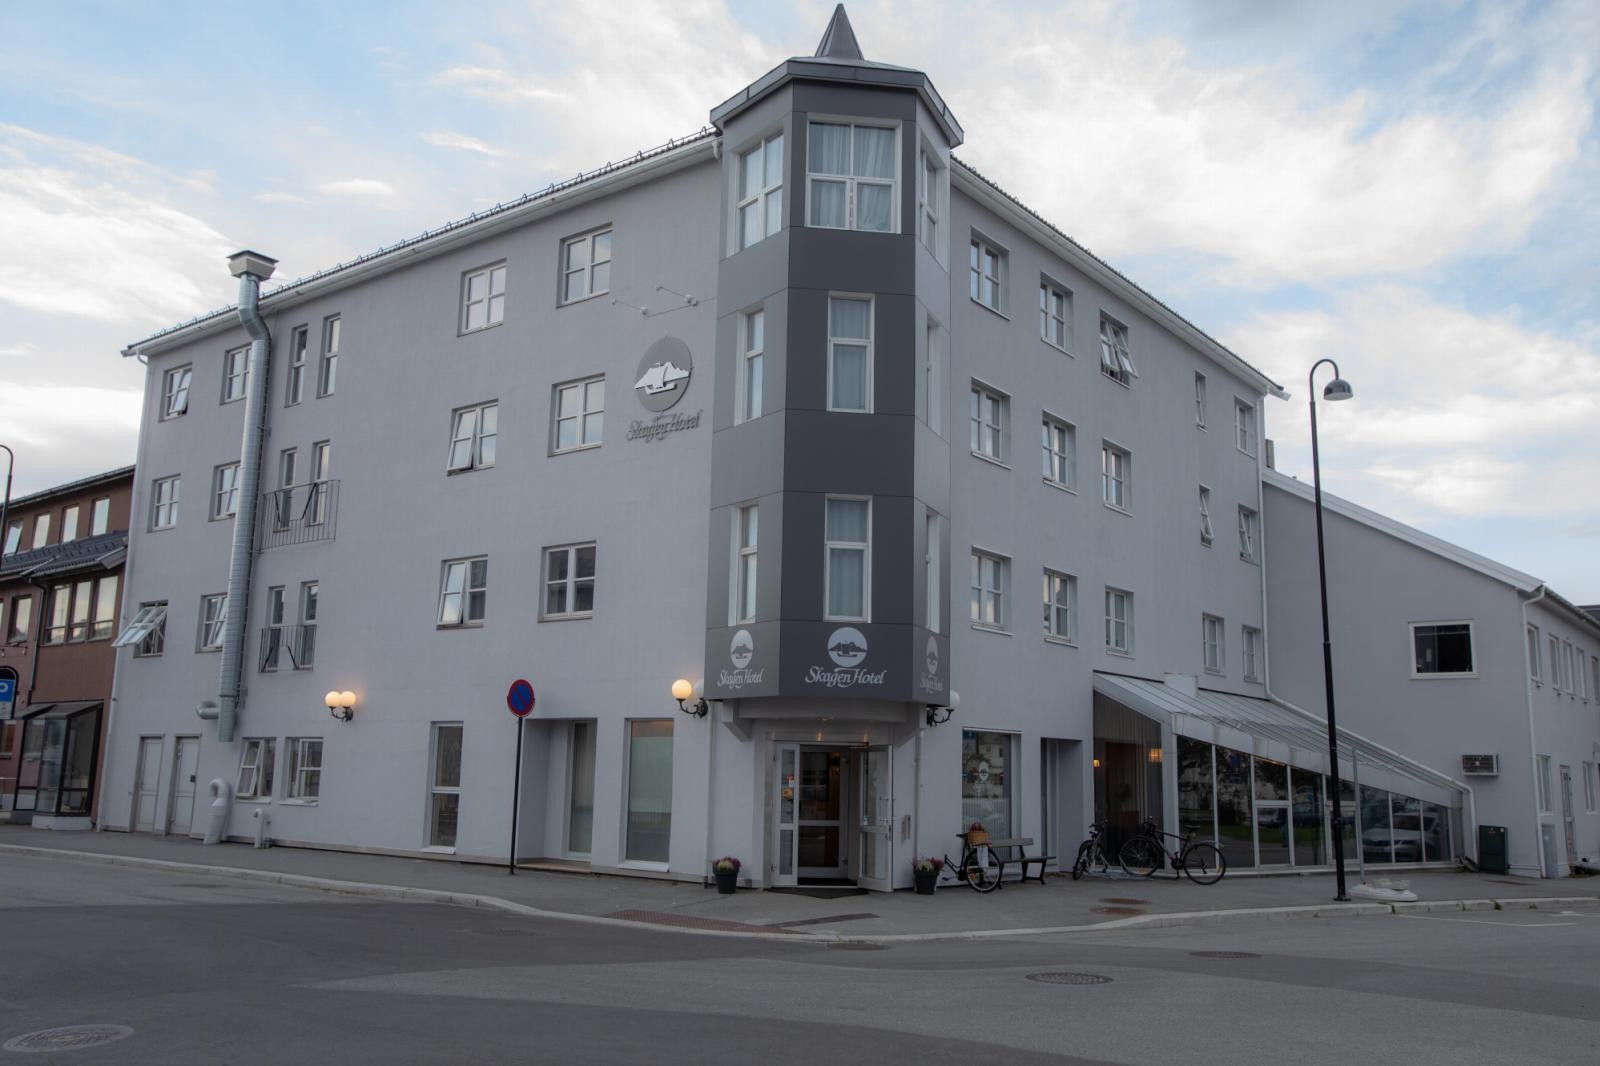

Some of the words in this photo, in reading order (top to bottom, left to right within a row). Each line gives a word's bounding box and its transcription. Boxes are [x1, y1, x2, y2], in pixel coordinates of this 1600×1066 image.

[717, 669, 744, 689] Skagen
[738, 667, 765, 687] Hotel
[804, 664, 852, 688] Skagen
[842, 667, 888, 686] Hotel
